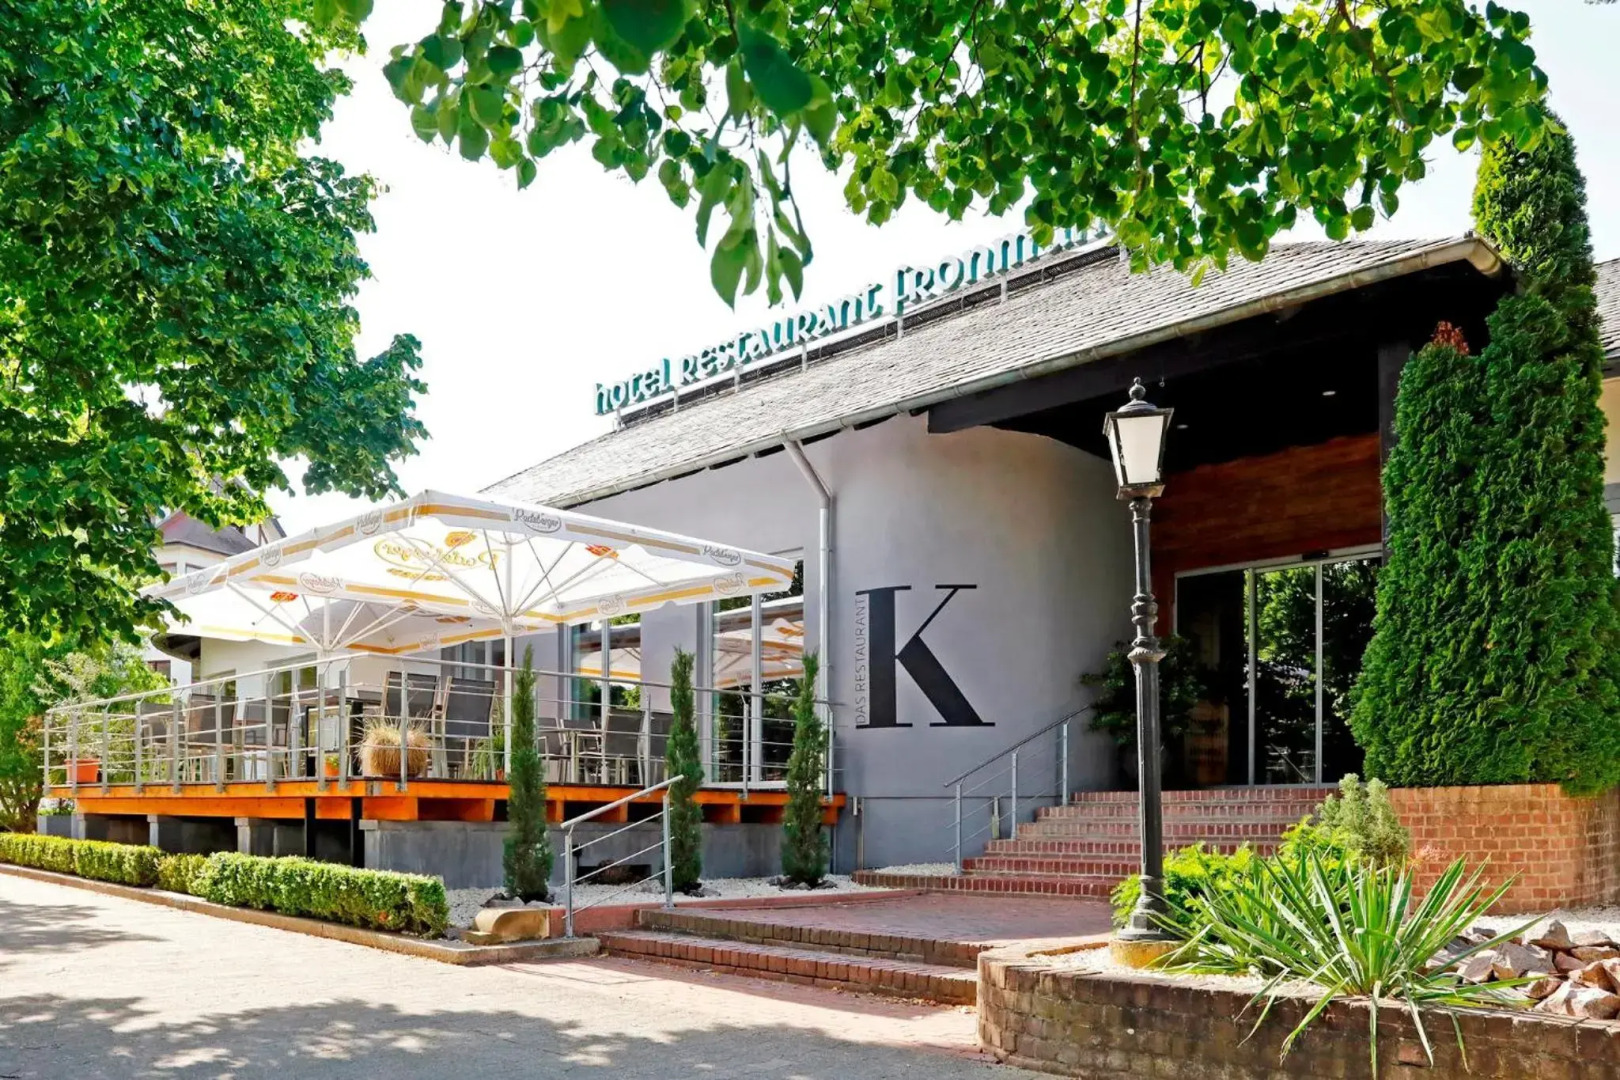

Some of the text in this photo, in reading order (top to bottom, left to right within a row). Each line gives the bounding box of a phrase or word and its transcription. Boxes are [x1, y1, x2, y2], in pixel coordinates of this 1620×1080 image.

[594, 357, 673, 415] hotel
[855, 584, 996, 729] K
[855, 600, 867, 725] DAS RESTAURANT
